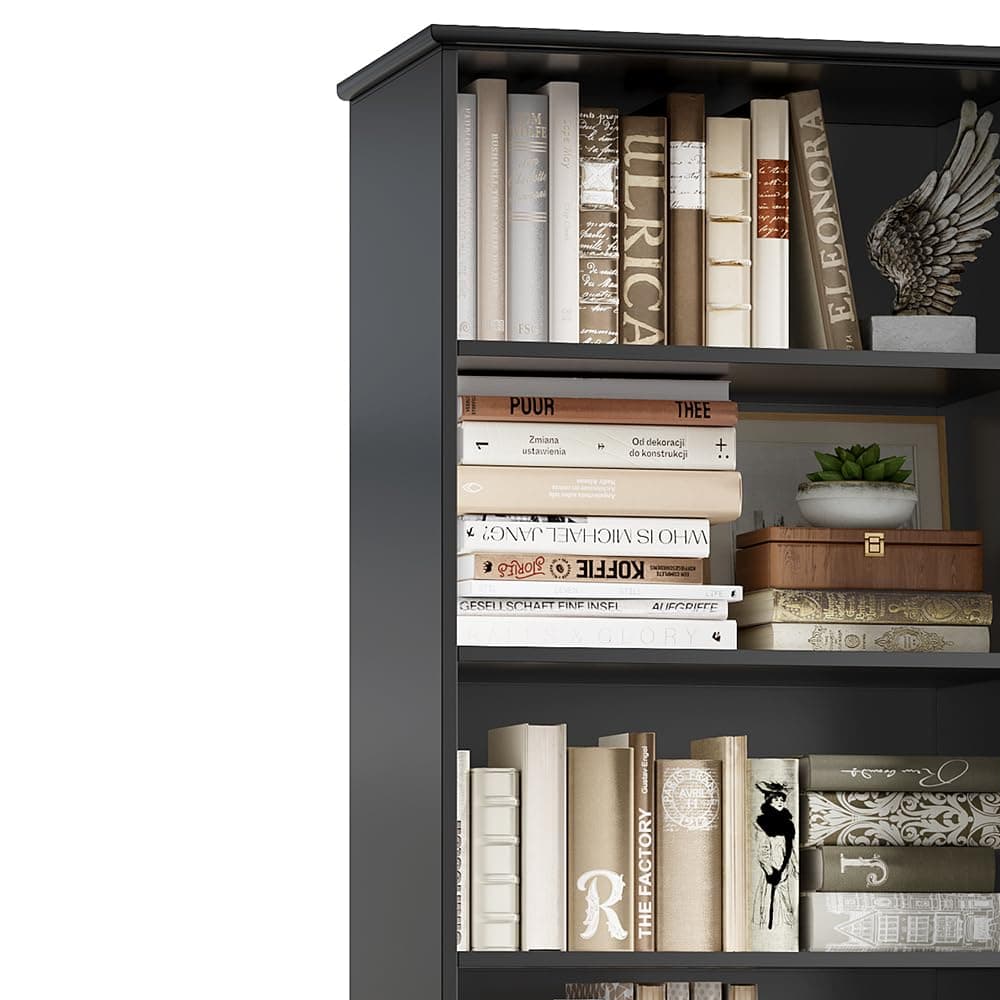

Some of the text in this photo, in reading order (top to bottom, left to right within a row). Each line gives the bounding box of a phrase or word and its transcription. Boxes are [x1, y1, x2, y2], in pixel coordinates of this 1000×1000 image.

[801, 107, 857, 325] ELEONORA
[510, 396, 711, 419] PUUR THEE
[475, 441, 489, 450] 1
[529, 435, 559, 445] Zmiana
[632, 437, 685, 449] Od dekoracji
[522, 446, 567, 456] ustawienia
[629, 448, 688, 460] do konstrukcji
[482, 525, 709, 545] WHO IS MICHAEL JANG?
[576, 559, 645, 580] KOFFIE
[641, 745, 649, 794] Gustav Engel
[638, 807, 652, 939] THE FACTORY
[840, 853, 889, 888] J
[577, 869, 628, 940] R
